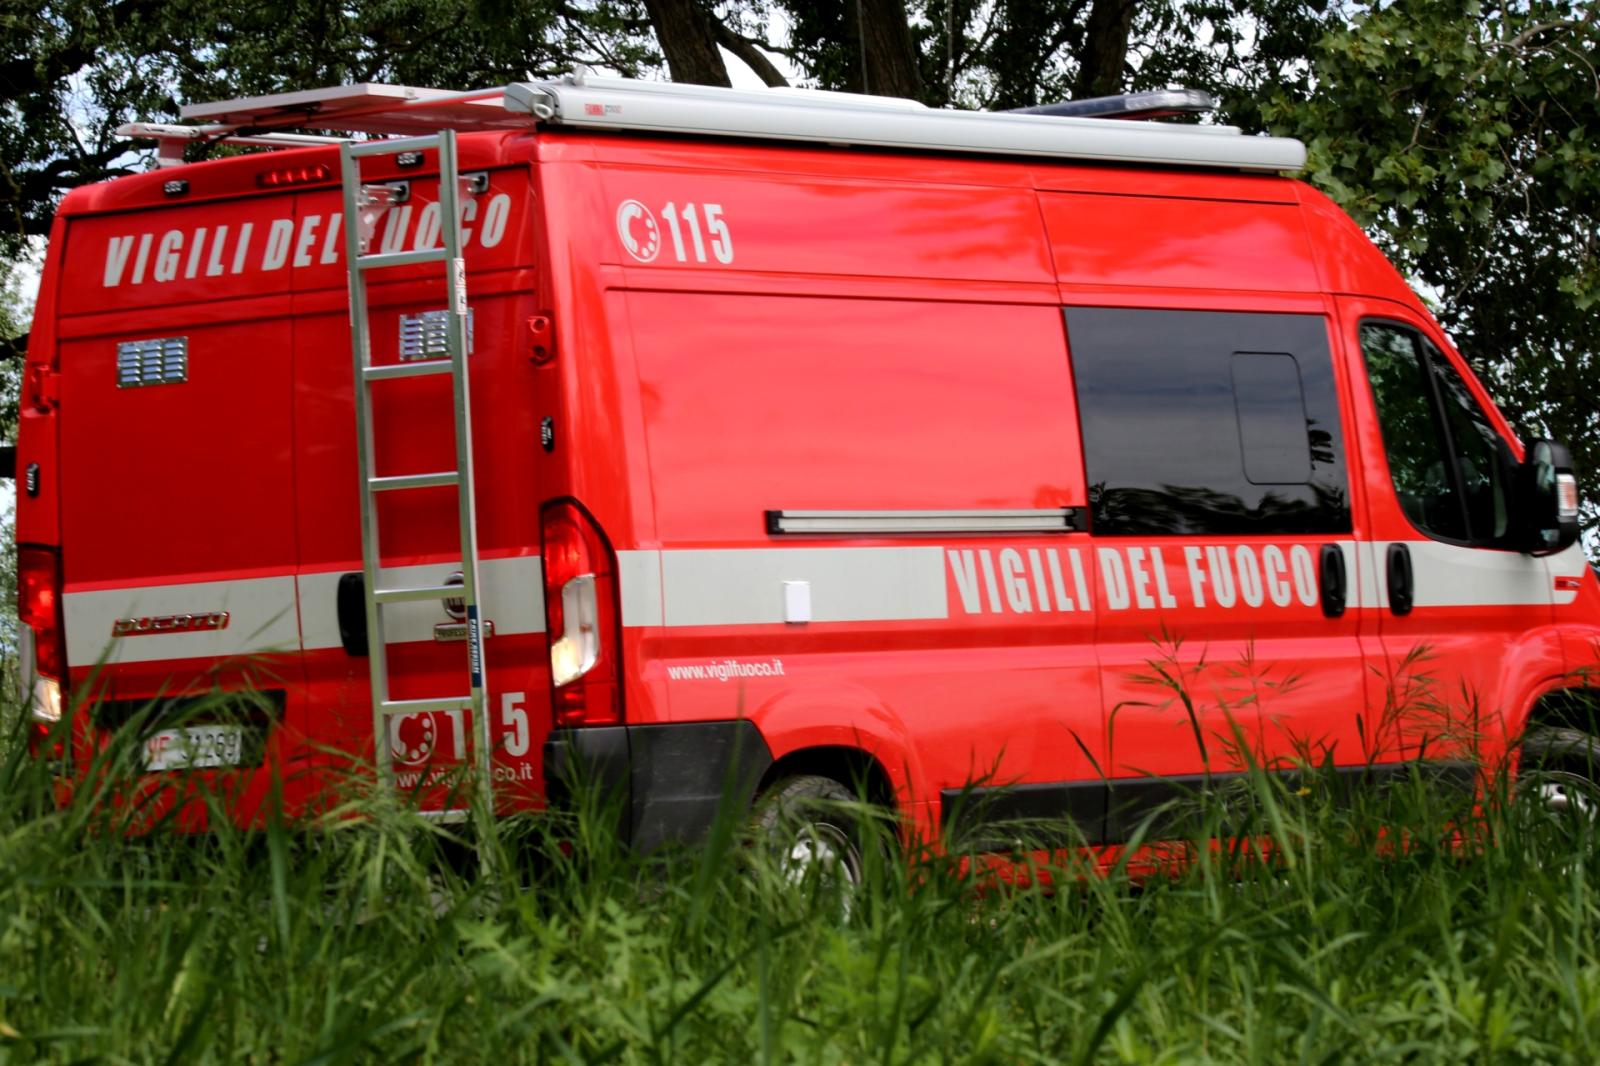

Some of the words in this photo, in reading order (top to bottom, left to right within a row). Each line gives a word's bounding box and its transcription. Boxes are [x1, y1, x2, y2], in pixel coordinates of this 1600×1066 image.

[103, 222, 254, 287] VIGILI
[261, 212, 343, 272] DEL
[362, 193, 511, 255] UOCO
[661, 201, 734, 264] 115
[946, 547, 1092, 614] VIGILI
[1097, 546, 1178, 610] DEL
[1183, 544, 1319, 608] FUOCO
[667, 658, 785, 682] www.vigilfuoco.it
[444, 691, 530, 759] 15
